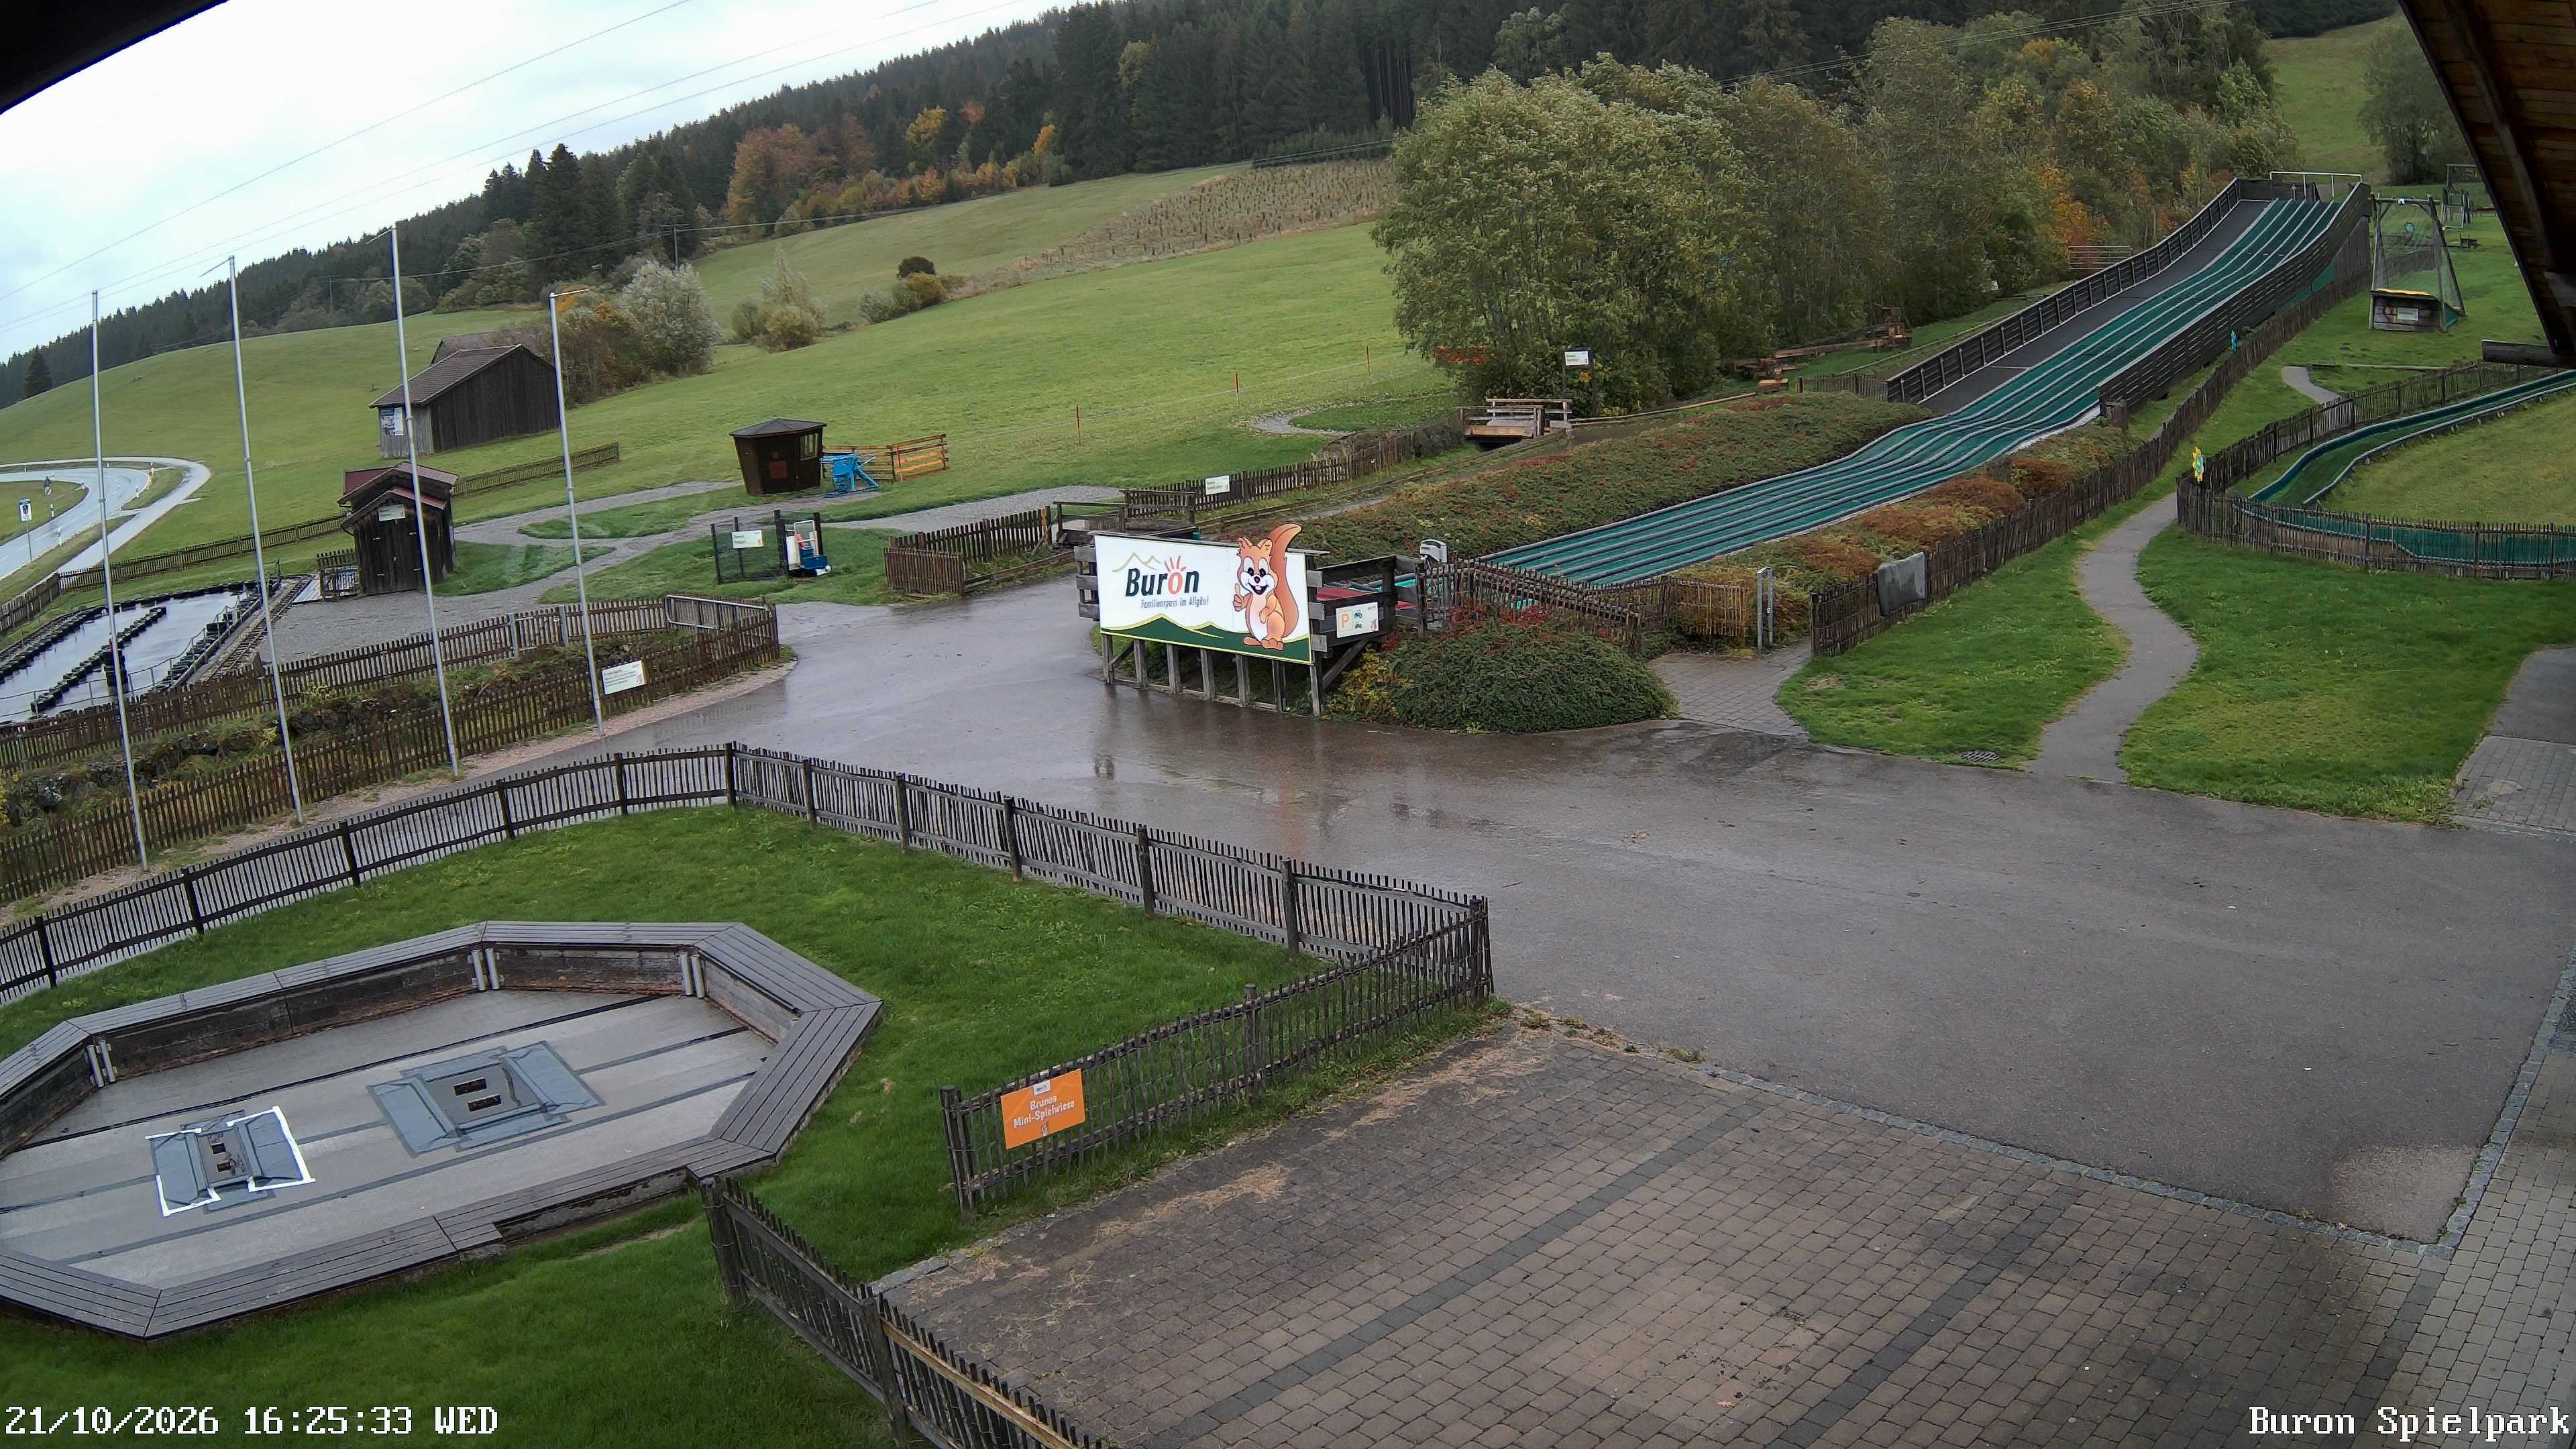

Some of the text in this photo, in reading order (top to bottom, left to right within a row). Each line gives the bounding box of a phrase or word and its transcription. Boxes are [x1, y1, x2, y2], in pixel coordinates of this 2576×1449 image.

[1125, 568, 1199, 597] Buron
[1342, 613, 1350, 629] P
[1013, 1100, 1075, 1128] Mini-Spielwiese
